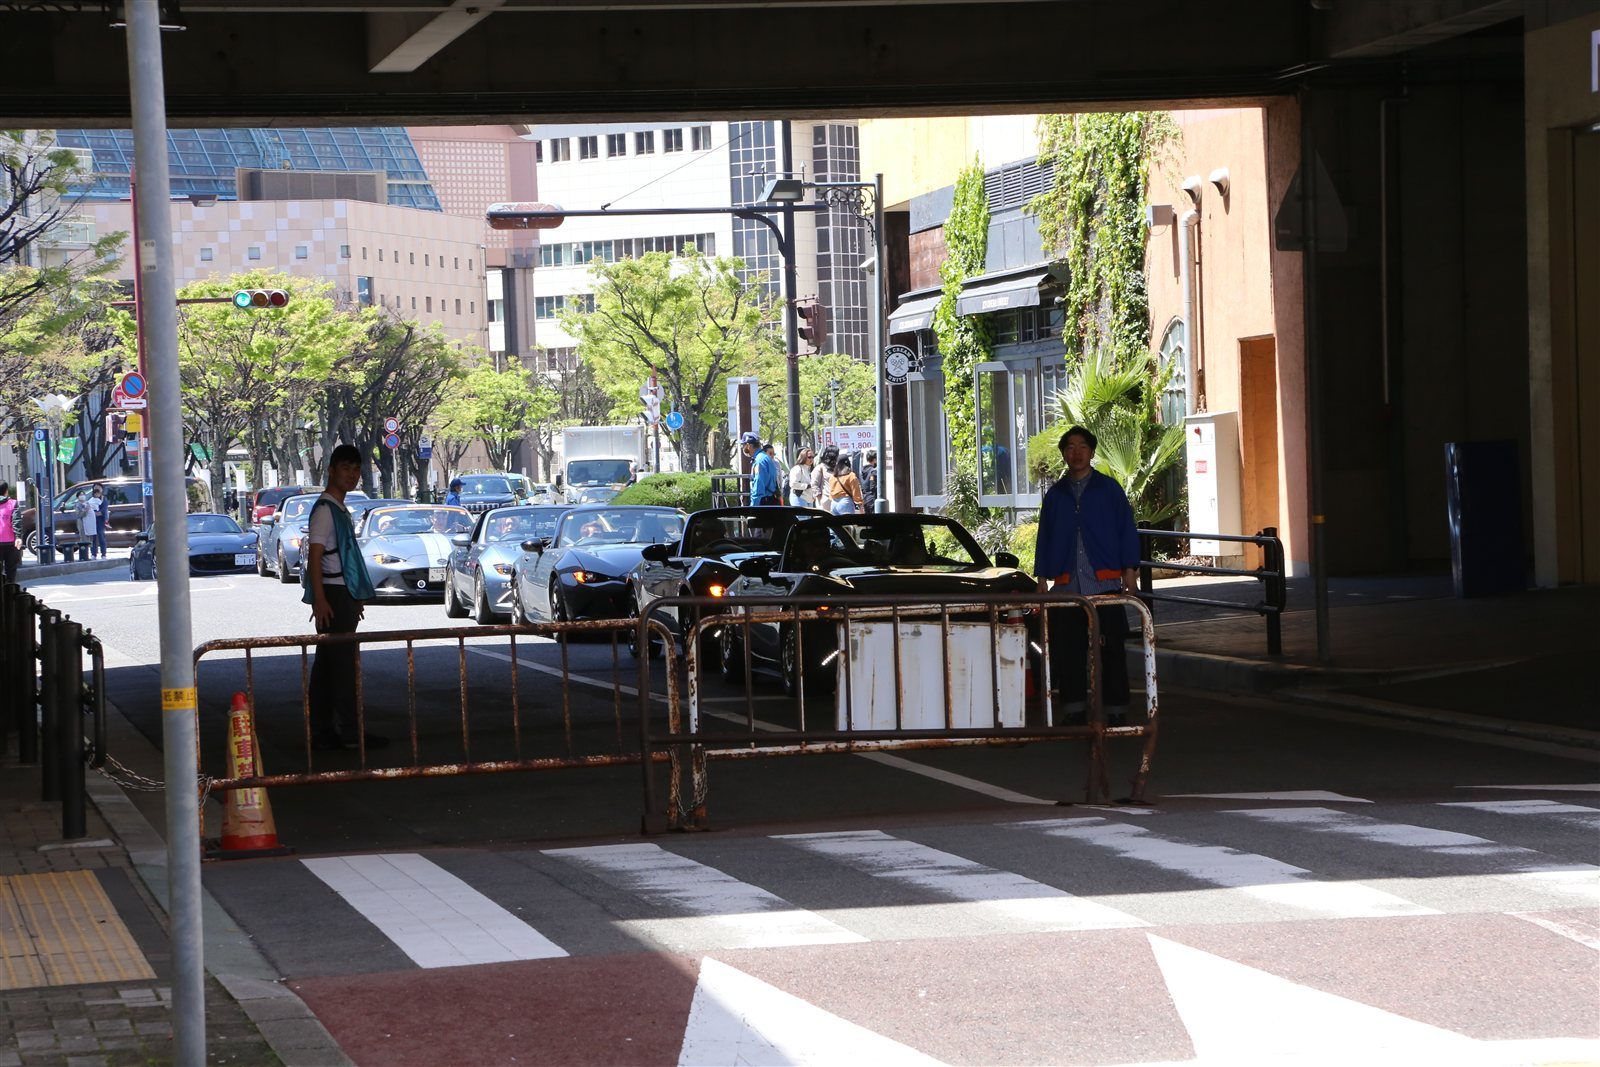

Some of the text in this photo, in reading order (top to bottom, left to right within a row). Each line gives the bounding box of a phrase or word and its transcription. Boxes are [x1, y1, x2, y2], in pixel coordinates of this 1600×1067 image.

[892, 347, 912, 358] CREAM
[857, 431, 871, 439] 900
[232, 716, 262, 807] 駐車禁止
